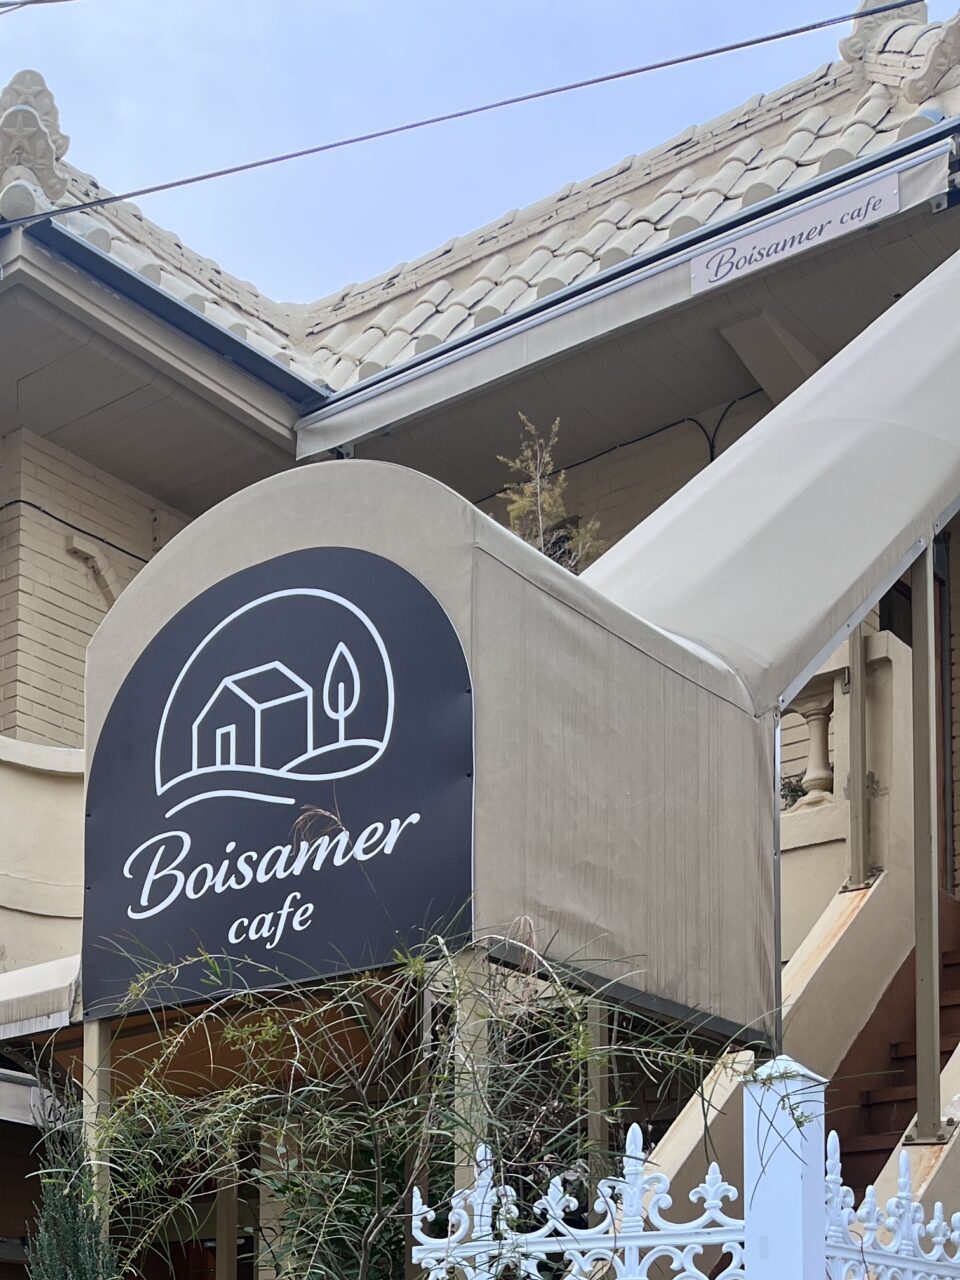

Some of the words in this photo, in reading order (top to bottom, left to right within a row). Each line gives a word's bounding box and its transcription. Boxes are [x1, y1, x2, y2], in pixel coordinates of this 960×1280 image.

[705, 219, 833, 284] Boisamer
[839, 195, 882, 224] cafe
[123, 812, 421, 920] Boisamer
[228, 891, 314, 950] cafe
